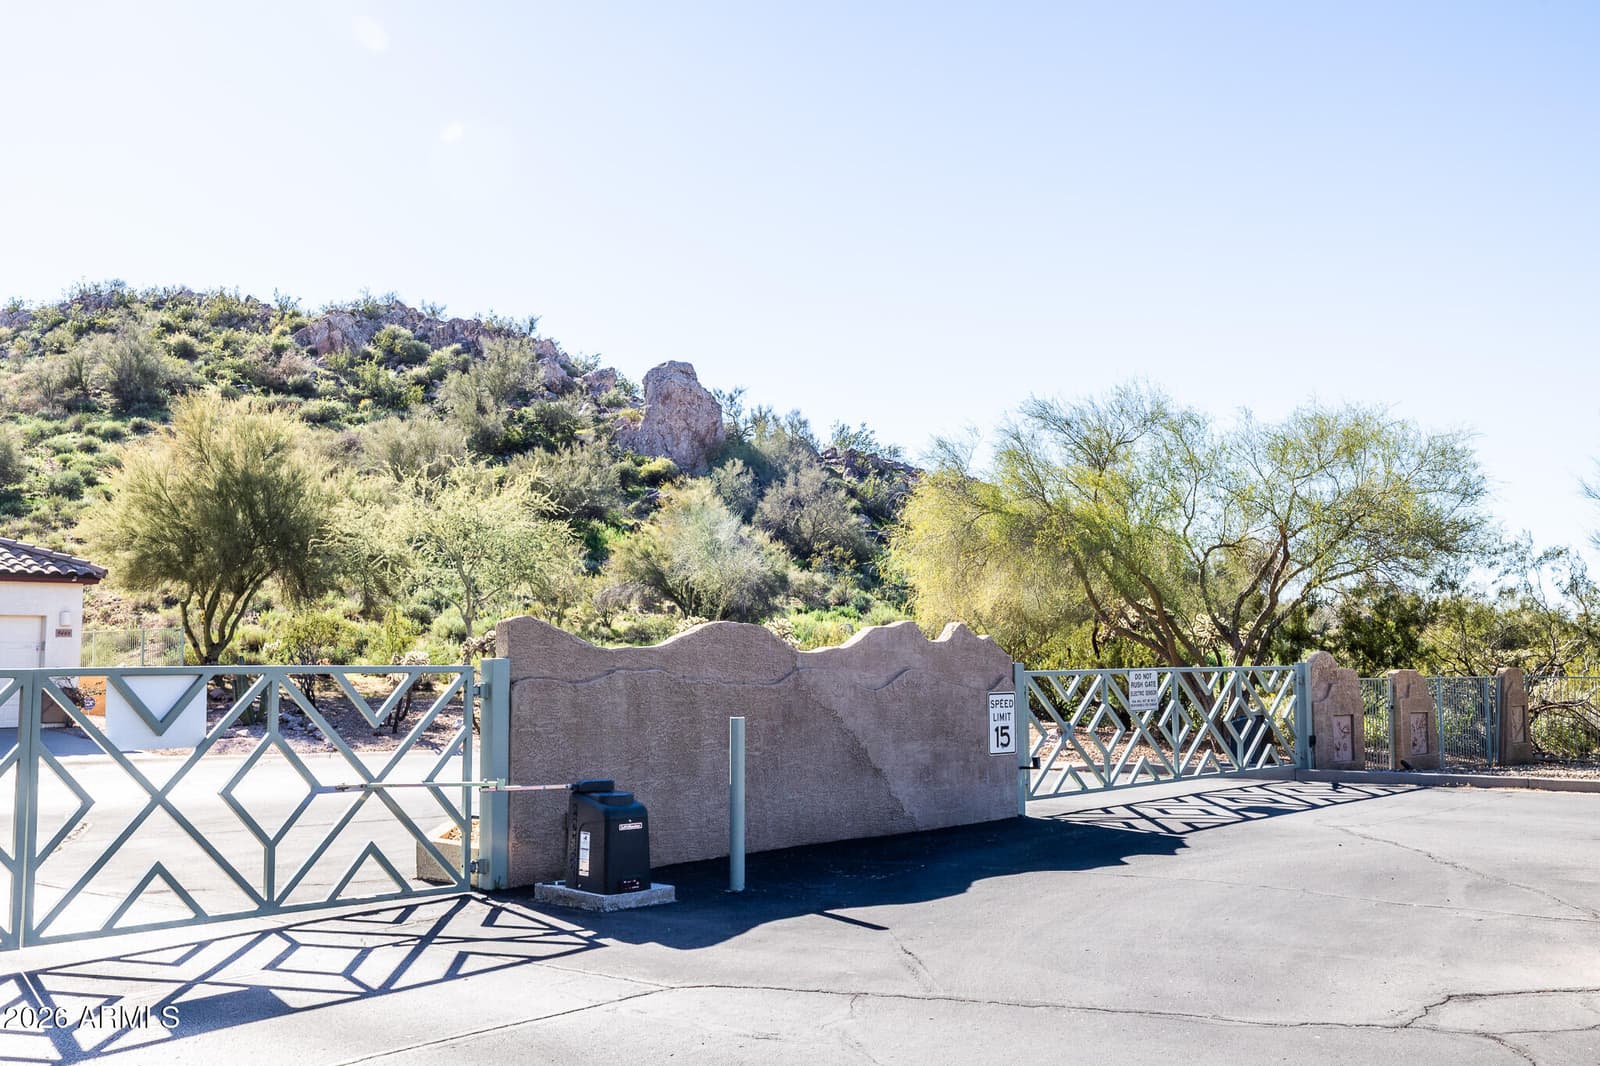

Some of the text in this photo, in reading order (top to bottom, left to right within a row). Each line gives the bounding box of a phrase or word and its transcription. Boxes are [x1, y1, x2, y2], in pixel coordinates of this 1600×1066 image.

[990, 700, 1013, 708] SPEED
[993, 712, 1011, 721] LIMIT
[994, 726, 1010, 748] 15
